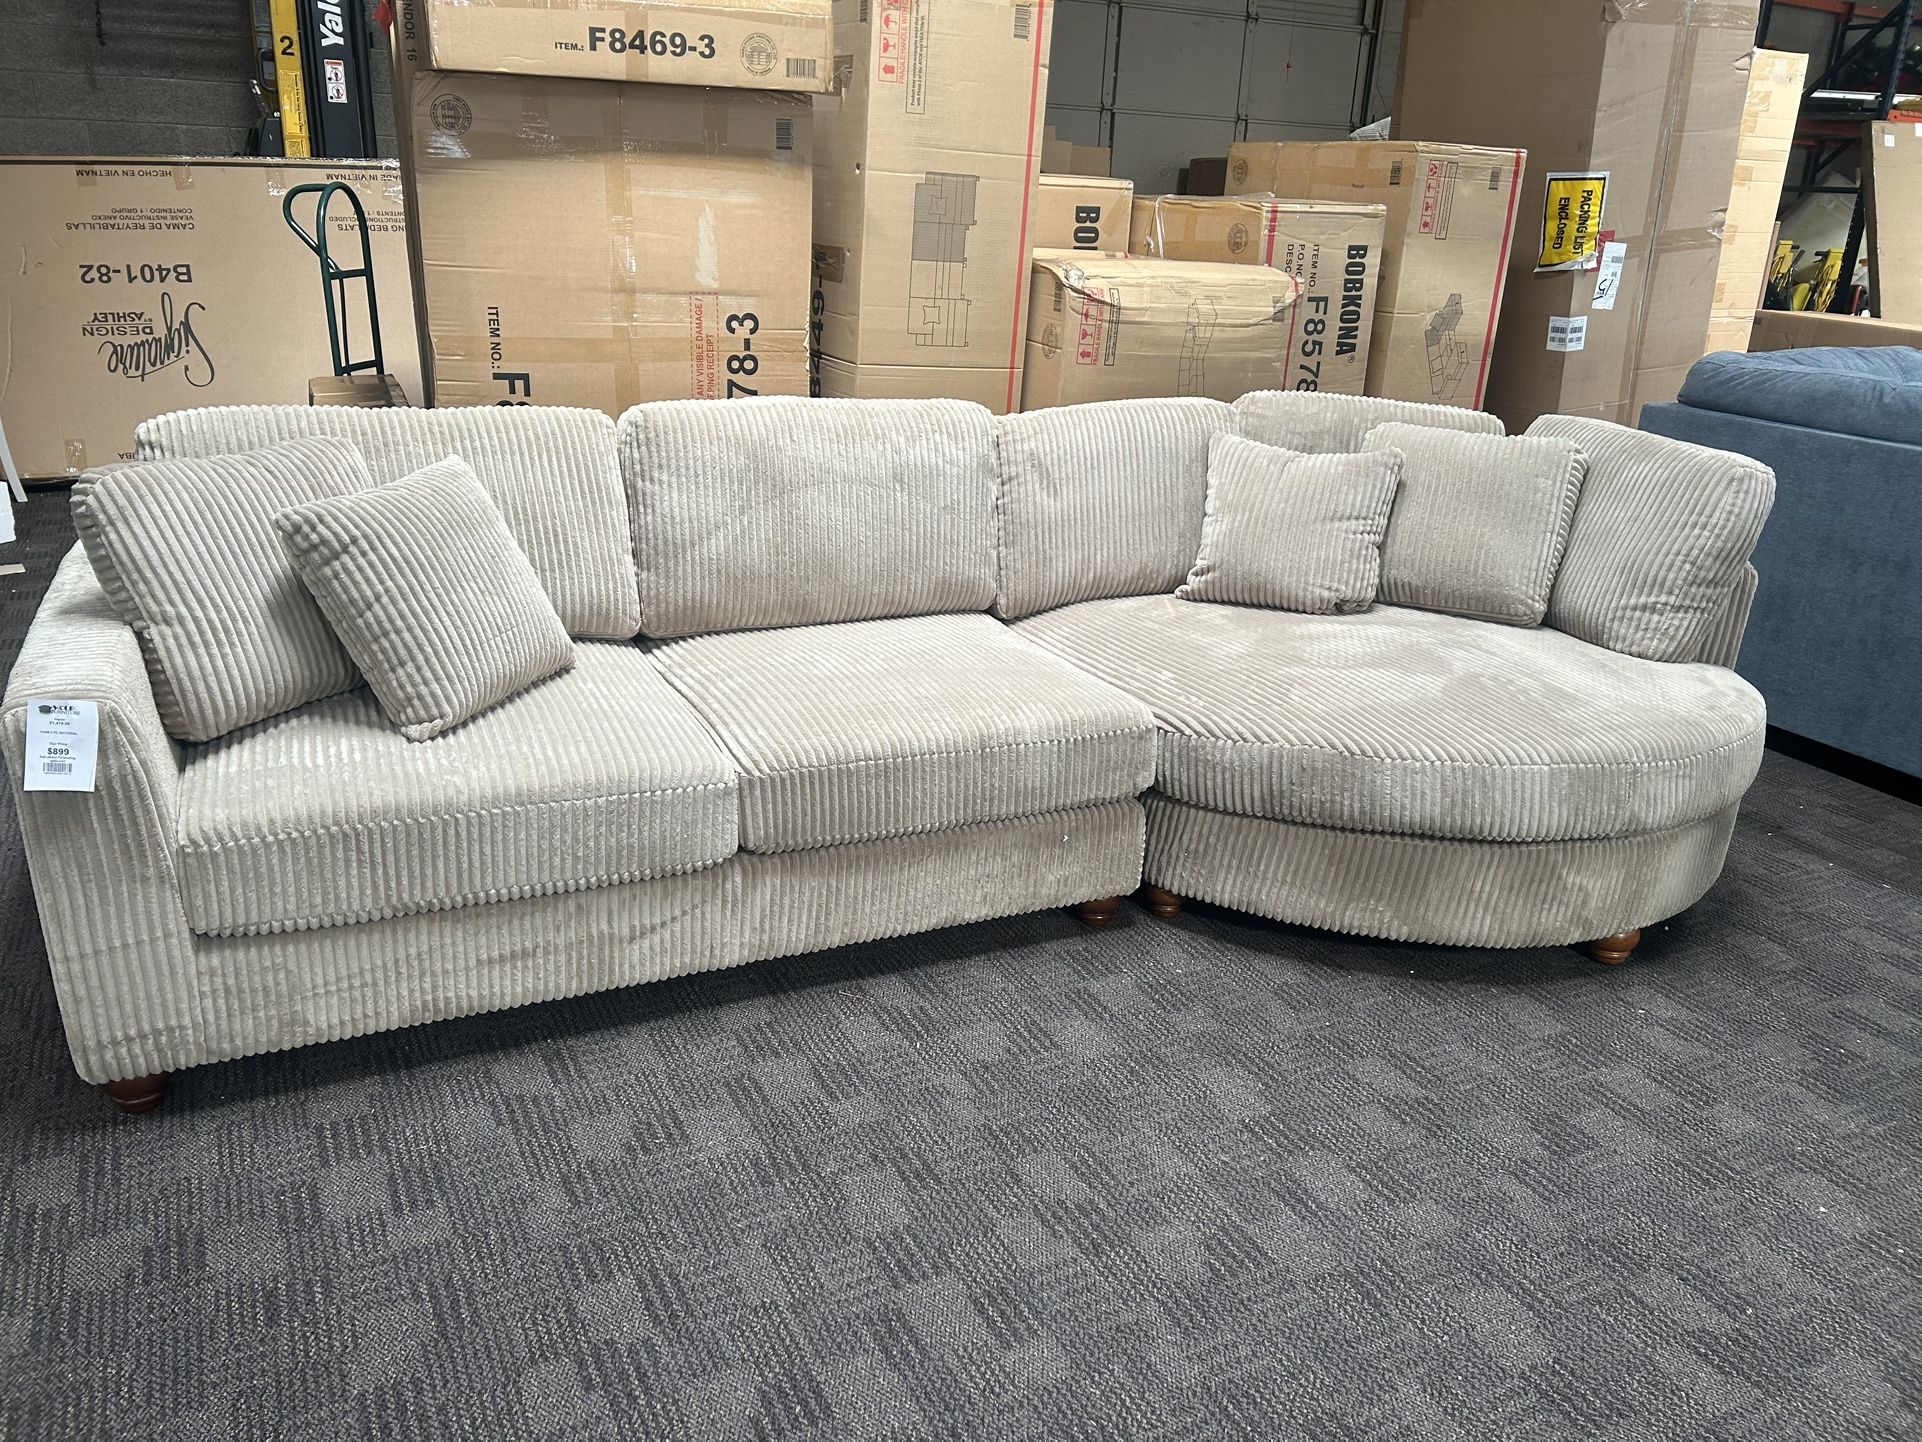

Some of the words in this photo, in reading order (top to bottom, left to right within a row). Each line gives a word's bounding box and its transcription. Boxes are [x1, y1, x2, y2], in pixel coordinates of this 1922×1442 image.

[317, 0, 345, 47] Yal
[403, 0, 416, 40] NDOR
[279, 35, 295, 56] 2
[407, 48, 417, 62] 16
[588, 26, 716, 59] F8469-3
[76, 169, 119, 177] VIETNAM
[326, 173, 367, 181] VIETNAM
[1552, 196, 1570, 250] ENCLOSED
[1576, 189, 1593, 234] PACKING
[65, 222, 146, 230] REY/TABLILLAS
[1073, 206, 1101, 250] BO
[1310, 244, 1320, 269] ITEM
[1572, 235, 1586, 257] LIST
[79, 264, 193, 284] B401-82
[1308, 272, 1317, 294] NO.:
[1335, 244, 1369, 356] BOBKONA
[91, 311, 144, 323] ASHLEY
[487, 306, 501, 338] ITEM
[694, 304, 704, 342] DAMAGE
[82, 325, 154, 337] DESIGN
[98, 292, 215, 388] Signature
[490, 342, 502, 369] NO.:
[696, 344, 704, 376] VISIBLE
[706, 333, 714, 370] RECEIPT
[726, 312, 760, 400] 78-3
[1093, 342, 1101, 366] FRAGILE
[696, 378, 704, 396] ANY
[47, 747, 69, 755] $899
